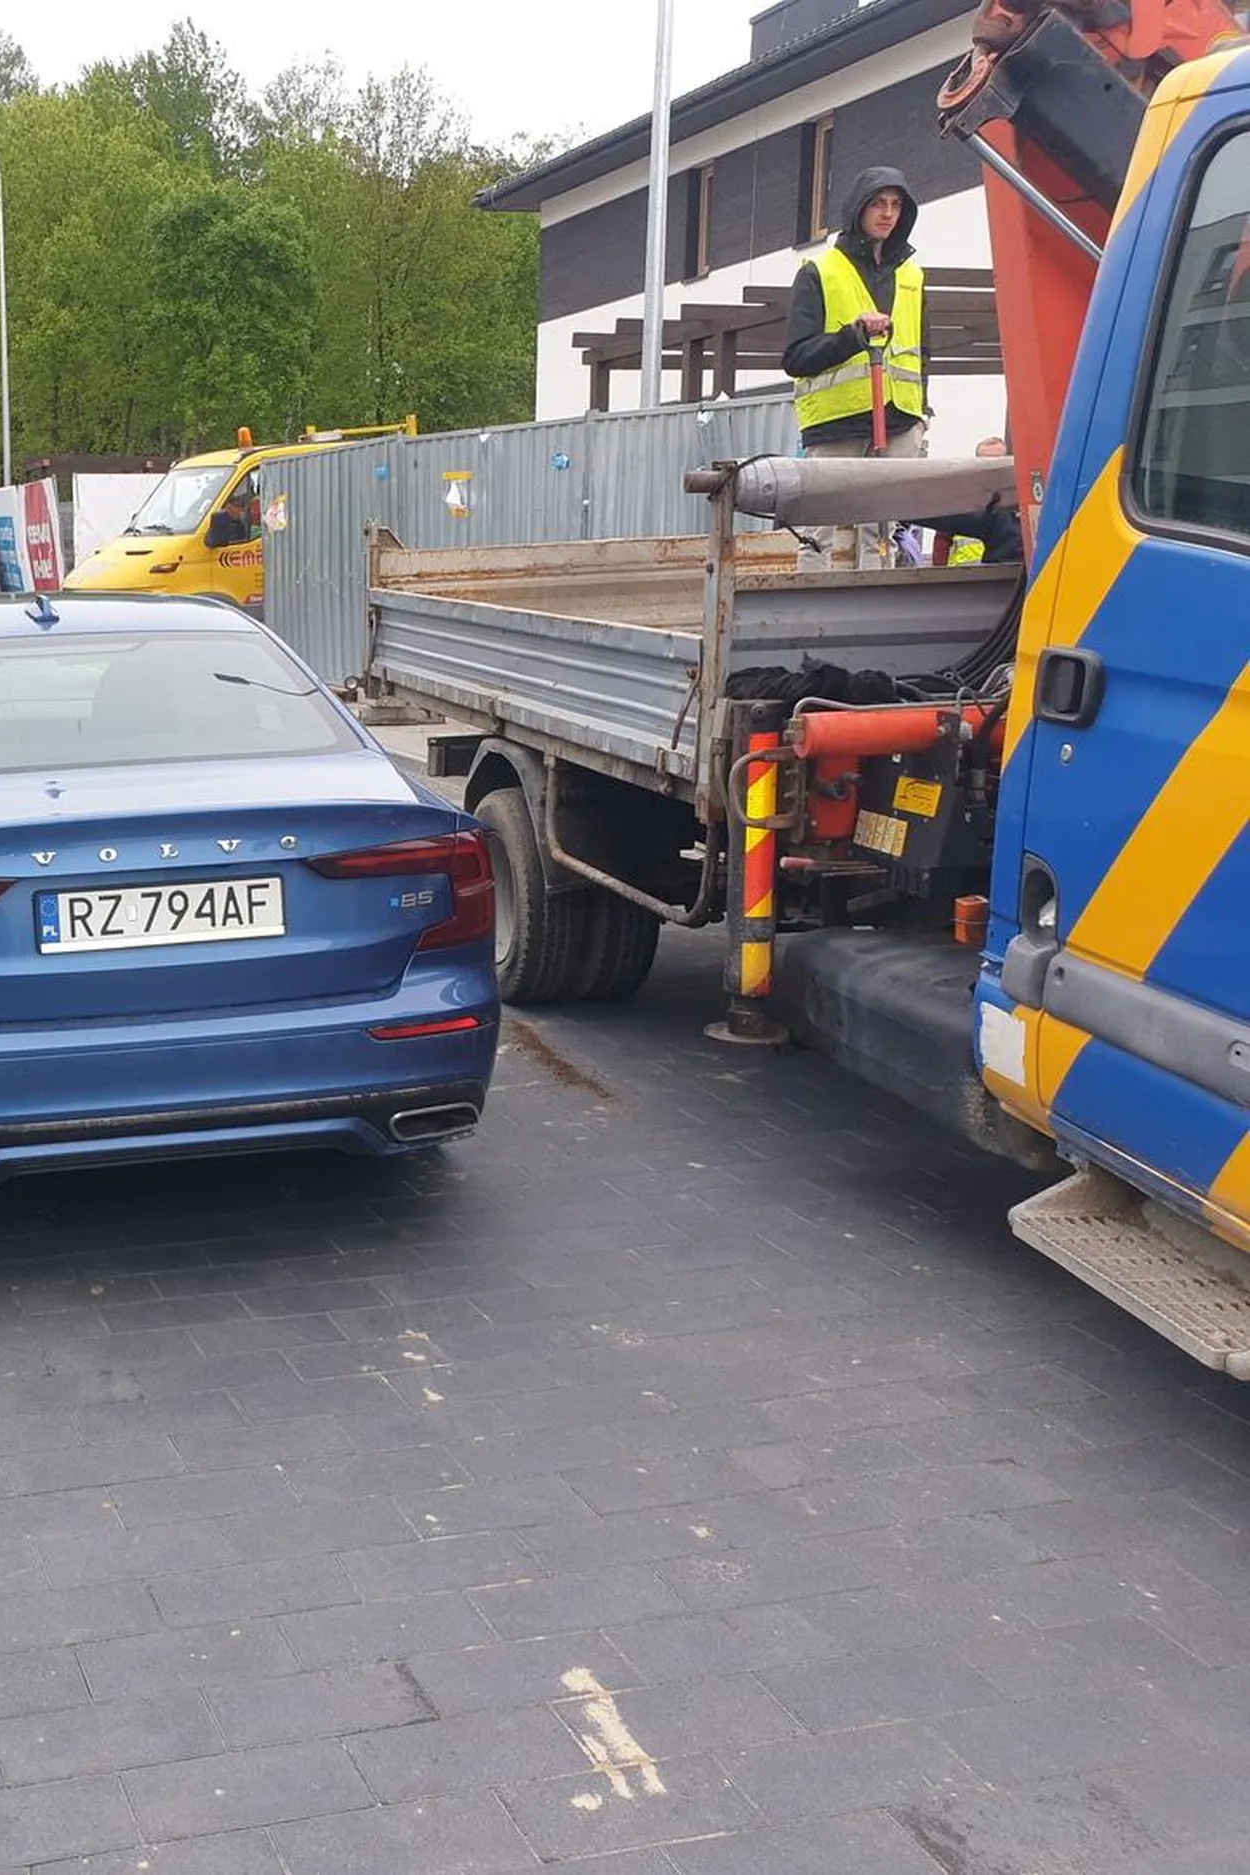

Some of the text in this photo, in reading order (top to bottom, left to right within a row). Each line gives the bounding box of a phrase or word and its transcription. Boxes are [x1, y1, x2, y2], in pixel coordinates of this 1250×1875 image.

[31, 835, 297, 866] VOLVO
[69, 884, 270, 938] RZ 794AF
[401, 890, 434, 908] B5
[43, 925, 57, 936] PL
